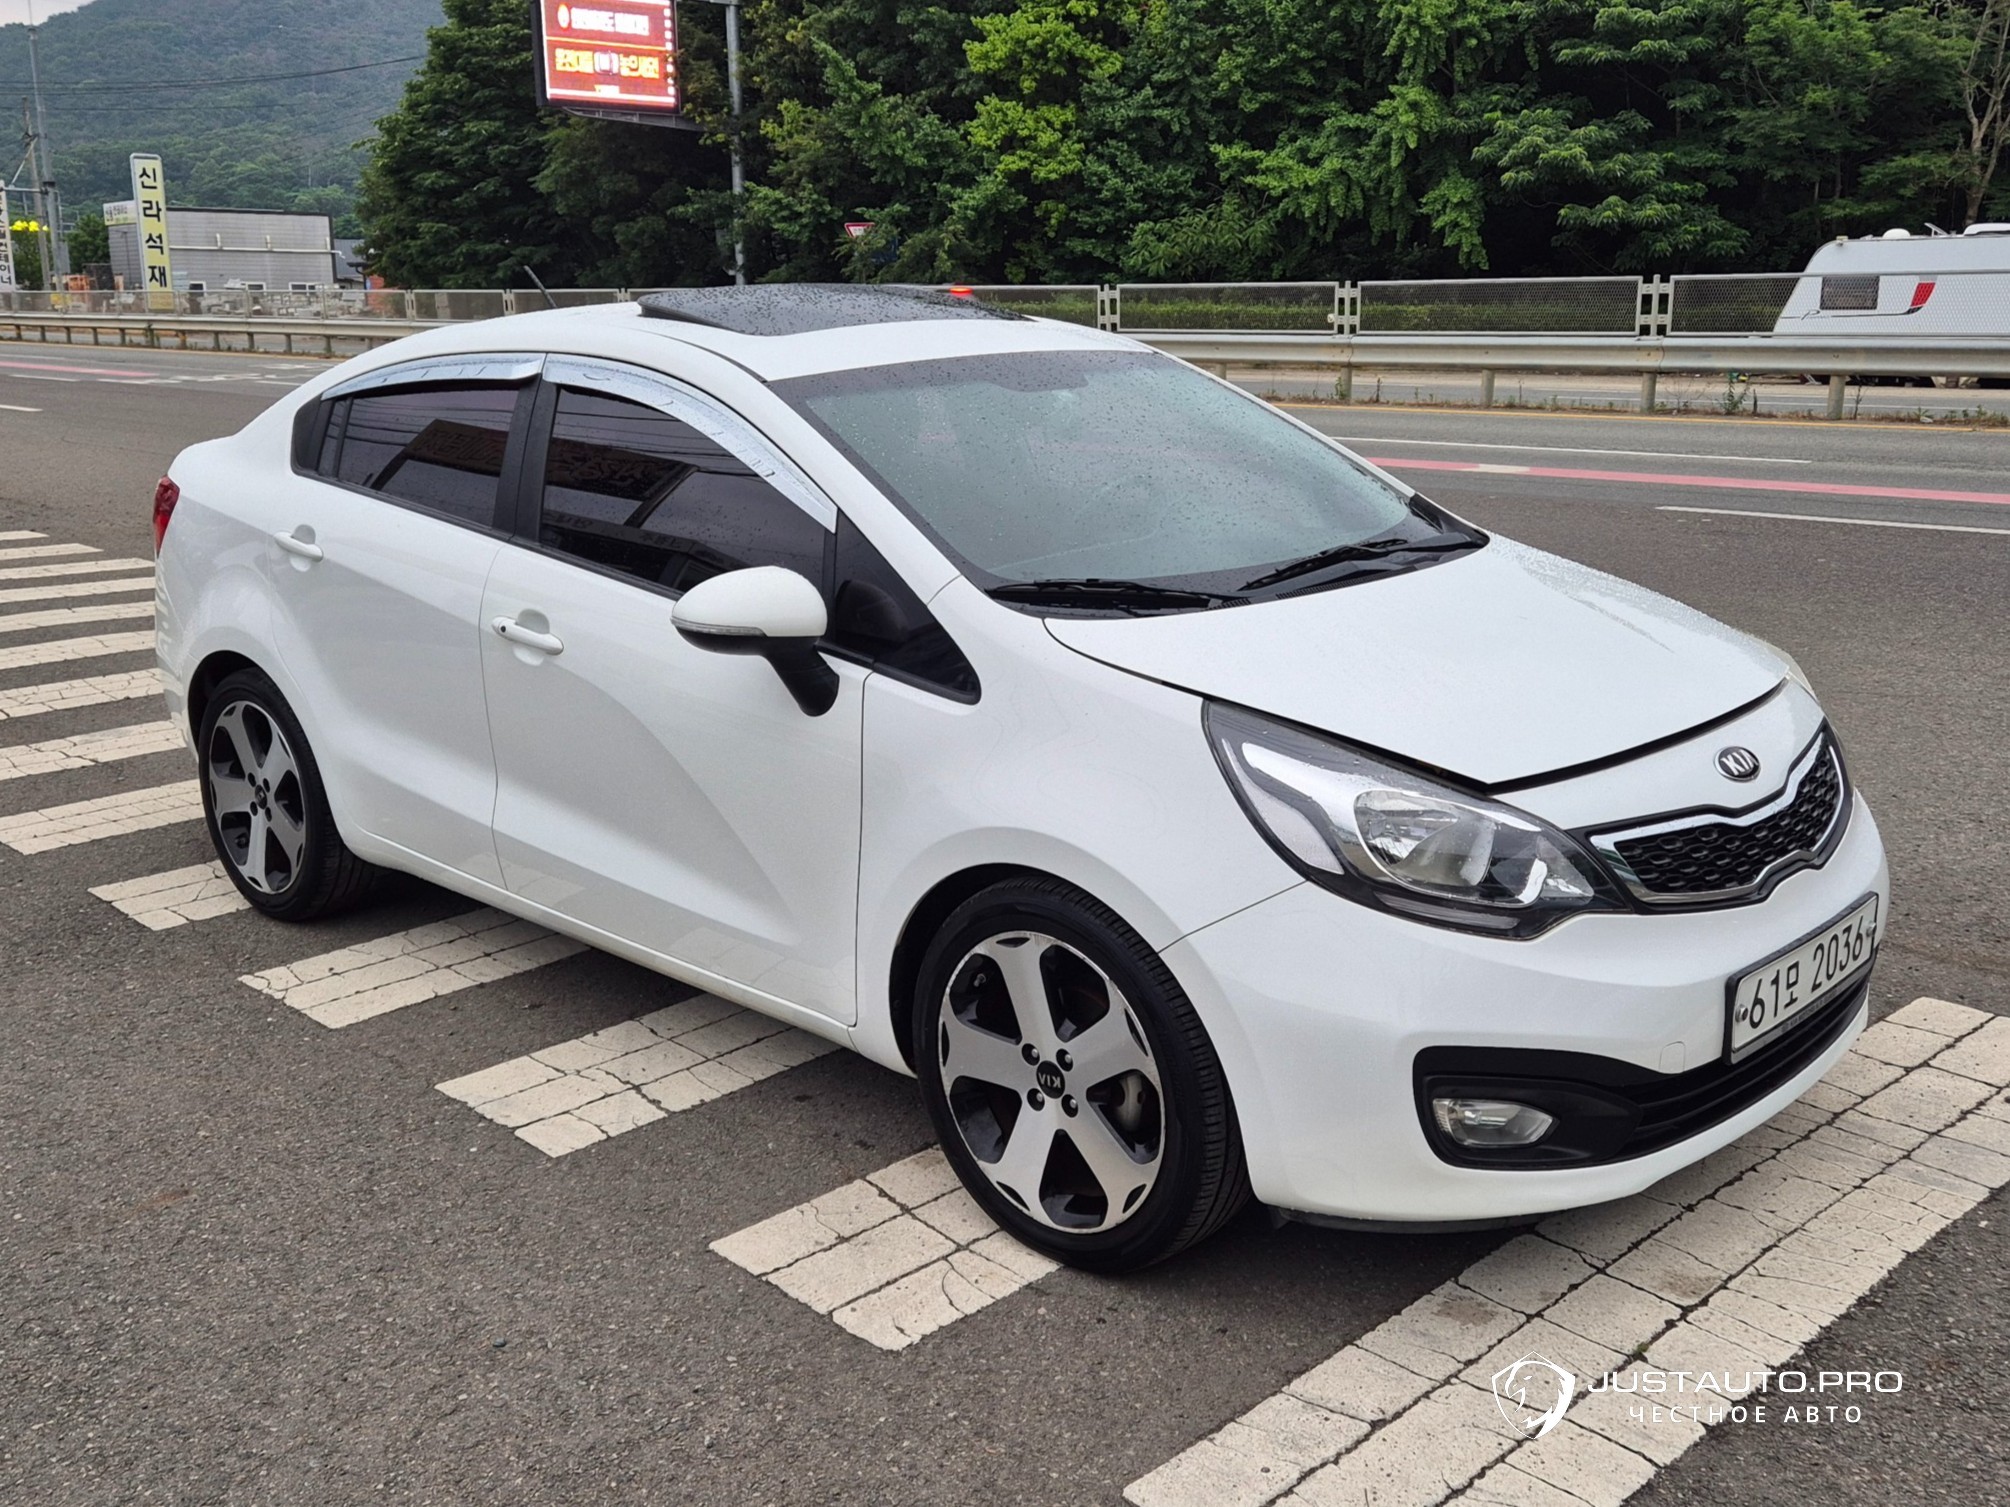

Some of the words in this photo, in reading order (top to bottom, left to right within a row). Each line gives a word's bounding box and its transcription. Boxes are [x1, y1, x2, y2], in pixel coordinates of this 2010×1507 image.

[139, 167, 168, 288] 신라석재
[1720, 749, 1759, 776] KIA
[1750, 960, 1800, 1029] 61모
[1811, 915, 1864, 993] 2036
[1038, 1073, 1062, 1089] KIA
